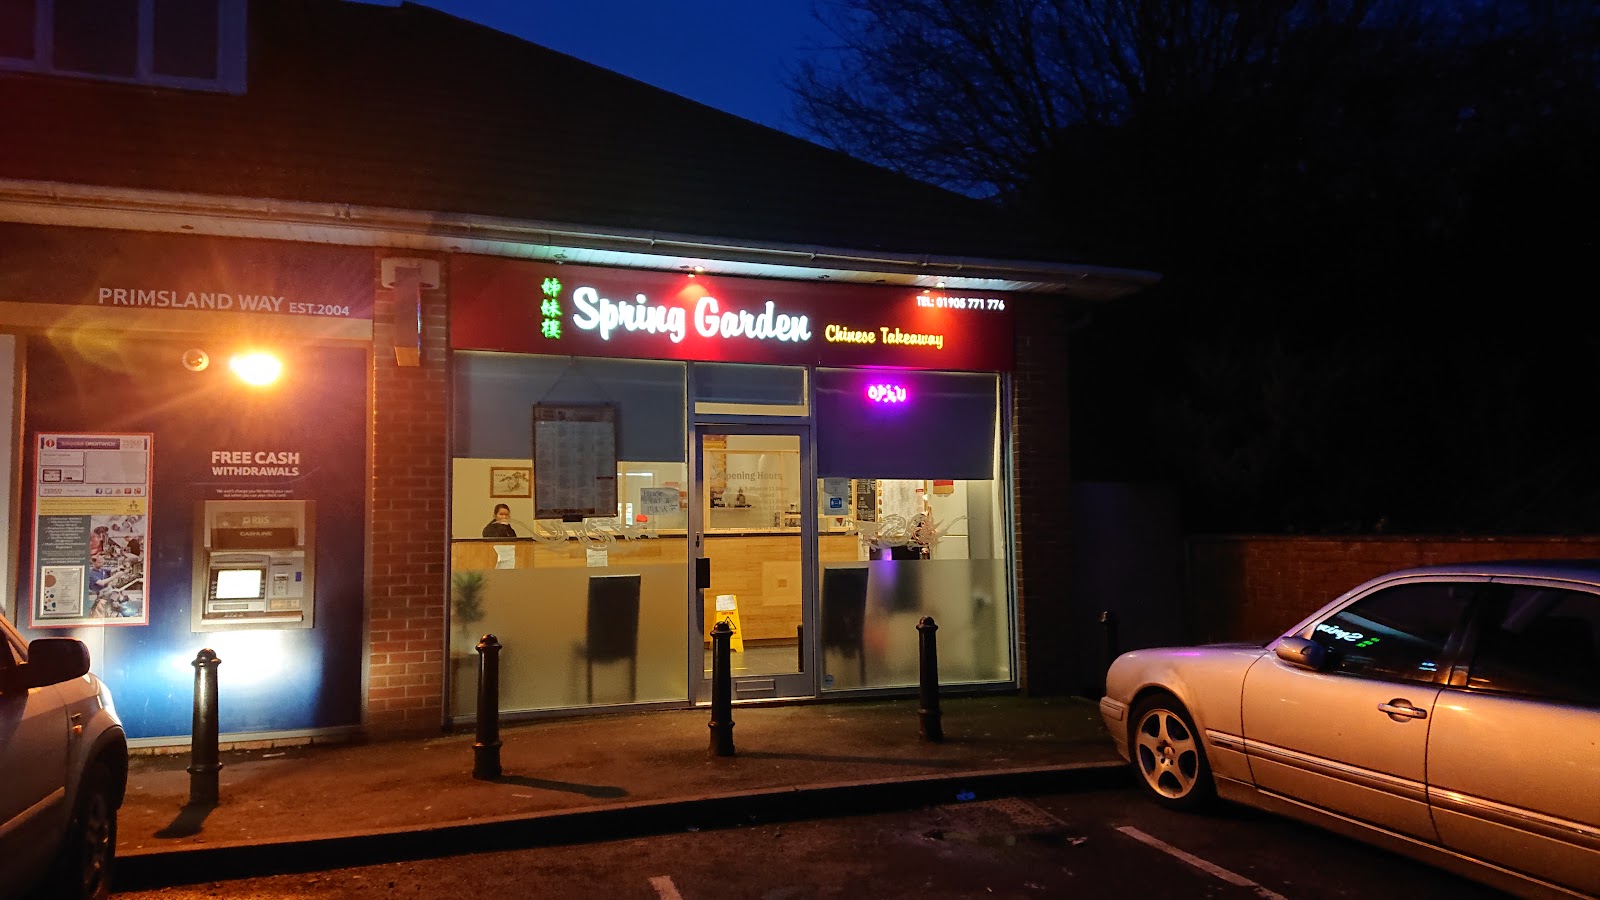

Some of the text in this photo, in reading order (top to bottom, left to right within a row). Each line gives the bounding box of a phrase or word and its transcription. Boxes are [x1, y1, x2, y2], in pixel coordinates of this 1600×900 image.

[97, 286, 350, 317] PRIMSLAND WAY EST.2004
[916, 296, 1005, 311] TEL: 01905 771 776
[572, 286, 812, 343] Spring Garden
[825, 324, 944, 350] Chinese Takeaway
[211, 451, 300, 465] FREE CASH
[211, 466, 299, 476] WITHDRAWALS
[757, 471, 783, 481] Hours
[251, 516, 270, 524] RBS
